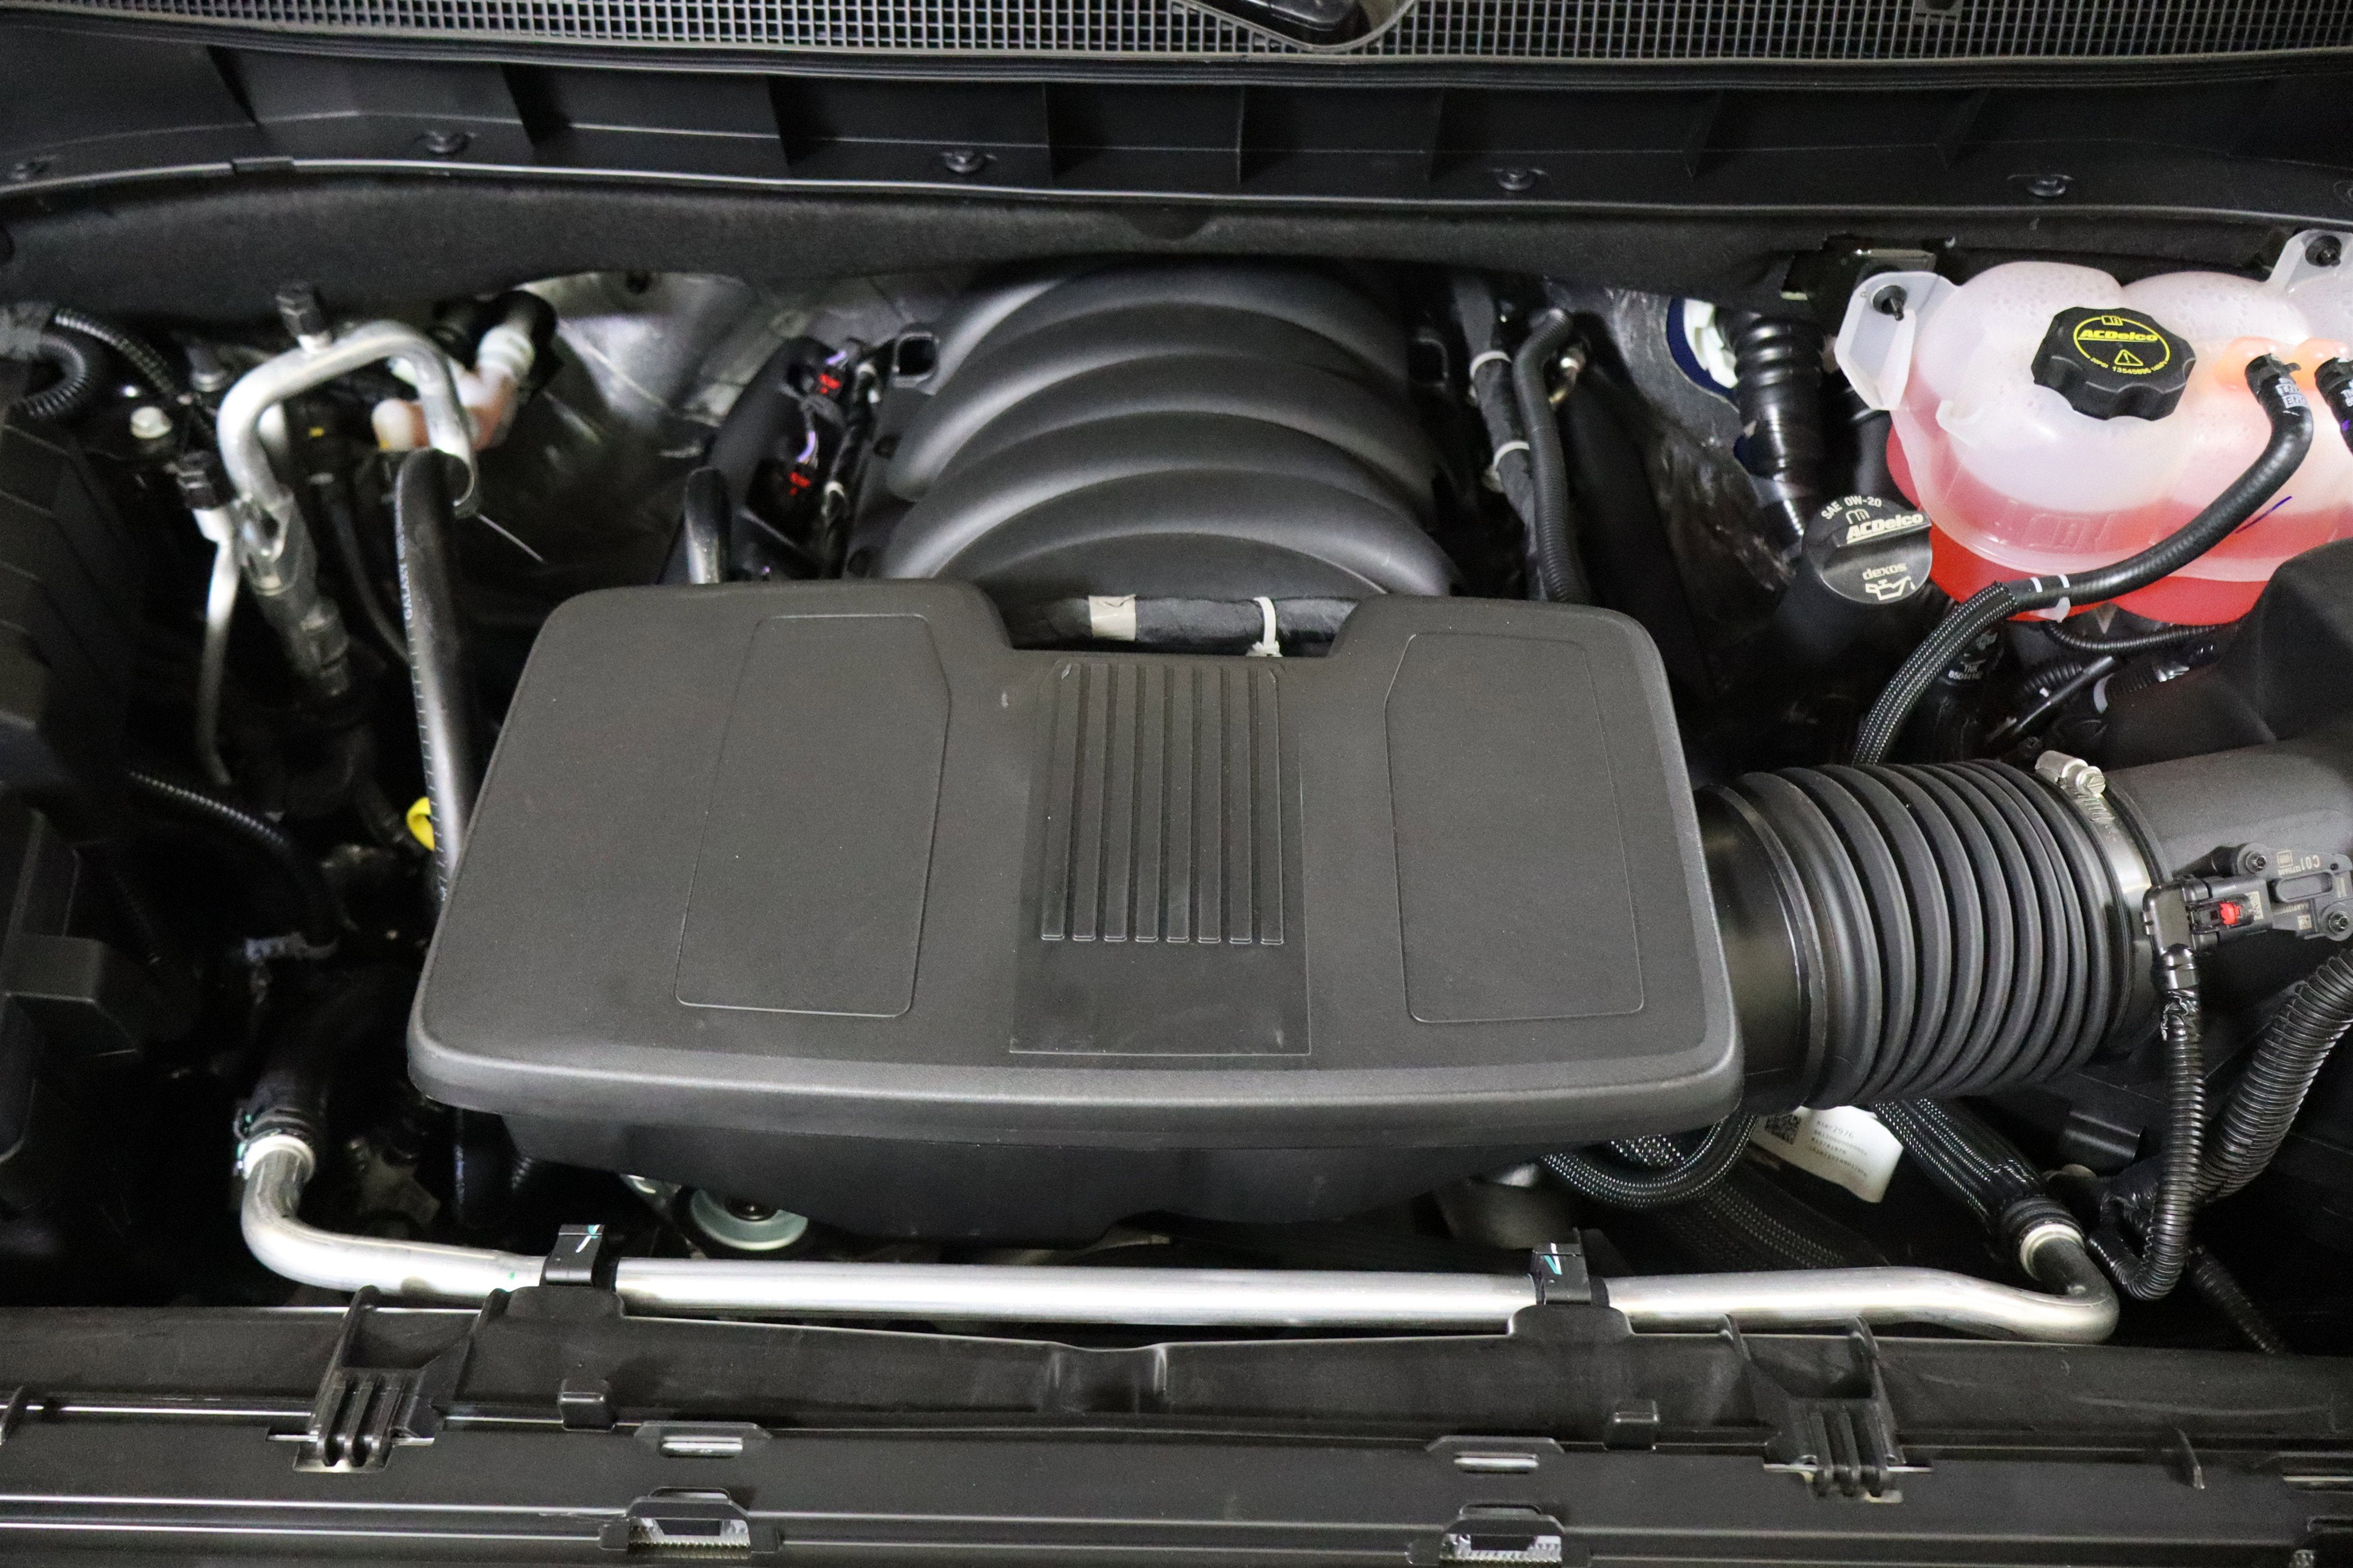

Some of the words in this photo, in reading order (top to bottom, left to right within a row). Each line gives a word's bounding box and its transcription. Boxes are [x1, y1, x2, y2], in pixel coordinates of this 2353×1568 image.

[2079, 329, 2158, 341] ACDelco
[1821, 501, 1842, 520] SAE
[1844, 495, 1882, 508] 0W-20
[1846, 513, 1924, 540] ACDelco
[1862, 563, 1907, 581] dexos
[2300, 855, 2320, 870] C01
